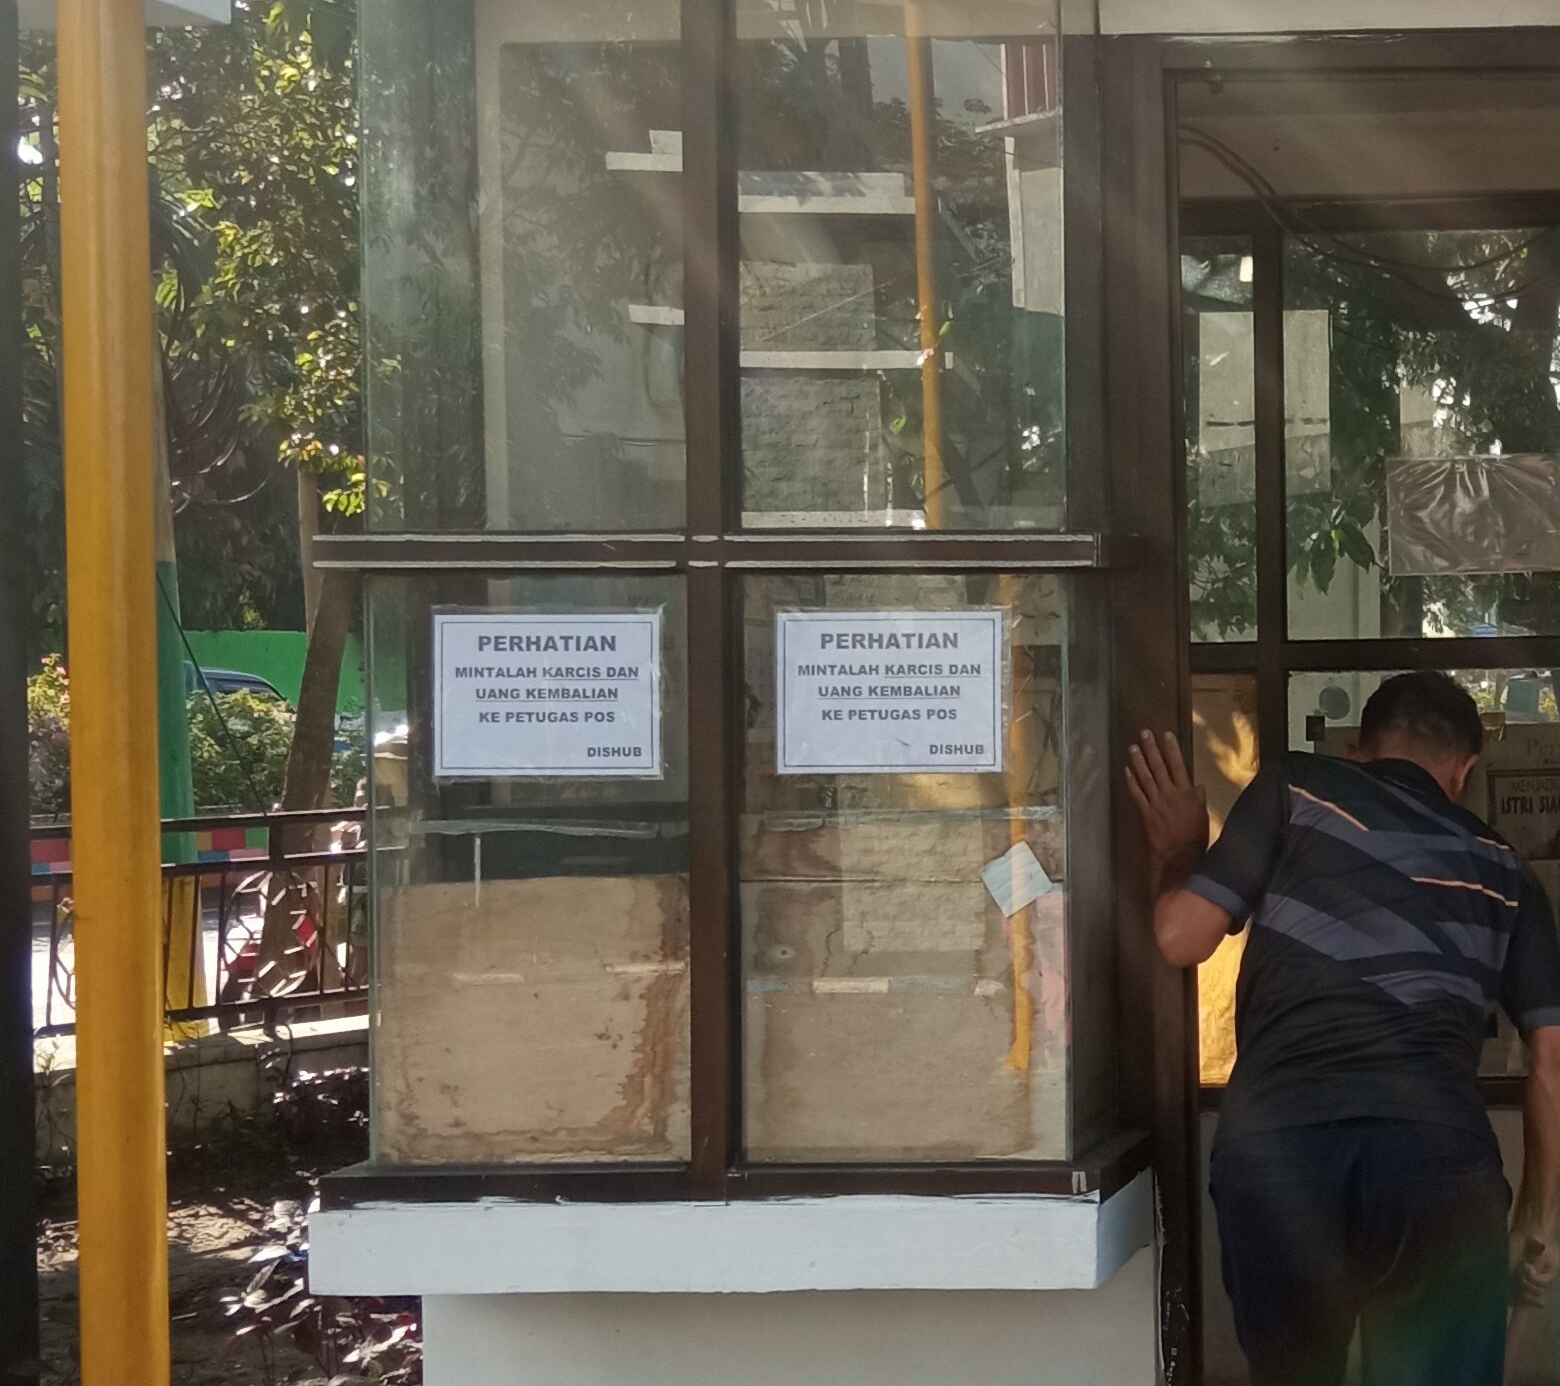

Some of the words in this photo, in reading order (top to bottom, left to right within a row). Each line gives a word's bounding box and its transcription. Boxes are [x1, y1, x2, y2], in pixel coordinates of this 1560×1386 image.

[477, 635, 617, 652] PERHATIAN
[820, 632, 959, 650] PERHATIAN
[455, 666, 537, 679] MINTALAH
[542, 666, 602, 679] KARCIS
[606, 666, 640, 678] DAN
[797, 664, 880, 676] MINTALAH
[884, 663, 944, 676] KARCIS
[948, 663, 982, 676] DAN
[475, 687, 521, 700] UANG
[526, 687, 619, 700] KEMBALIAN
[818, 685, 863, 698] UANG
[867, 685, 961, 697] KEMBALIAN
[479, 711, 501, 724] KE
[504, 711, 580, 724] PETUGAS
[584, 711, 616, 723] POS
[821, 709, 844, 721] KE
[848, 708, 921, 721] PETUGAS
[926, 708, 958, 721] POS
[586, 746, 642, 758] DISHUB
[928, 744, 985, 756] DISHUB
[1501, 796, 1533, 814] ISTRI
